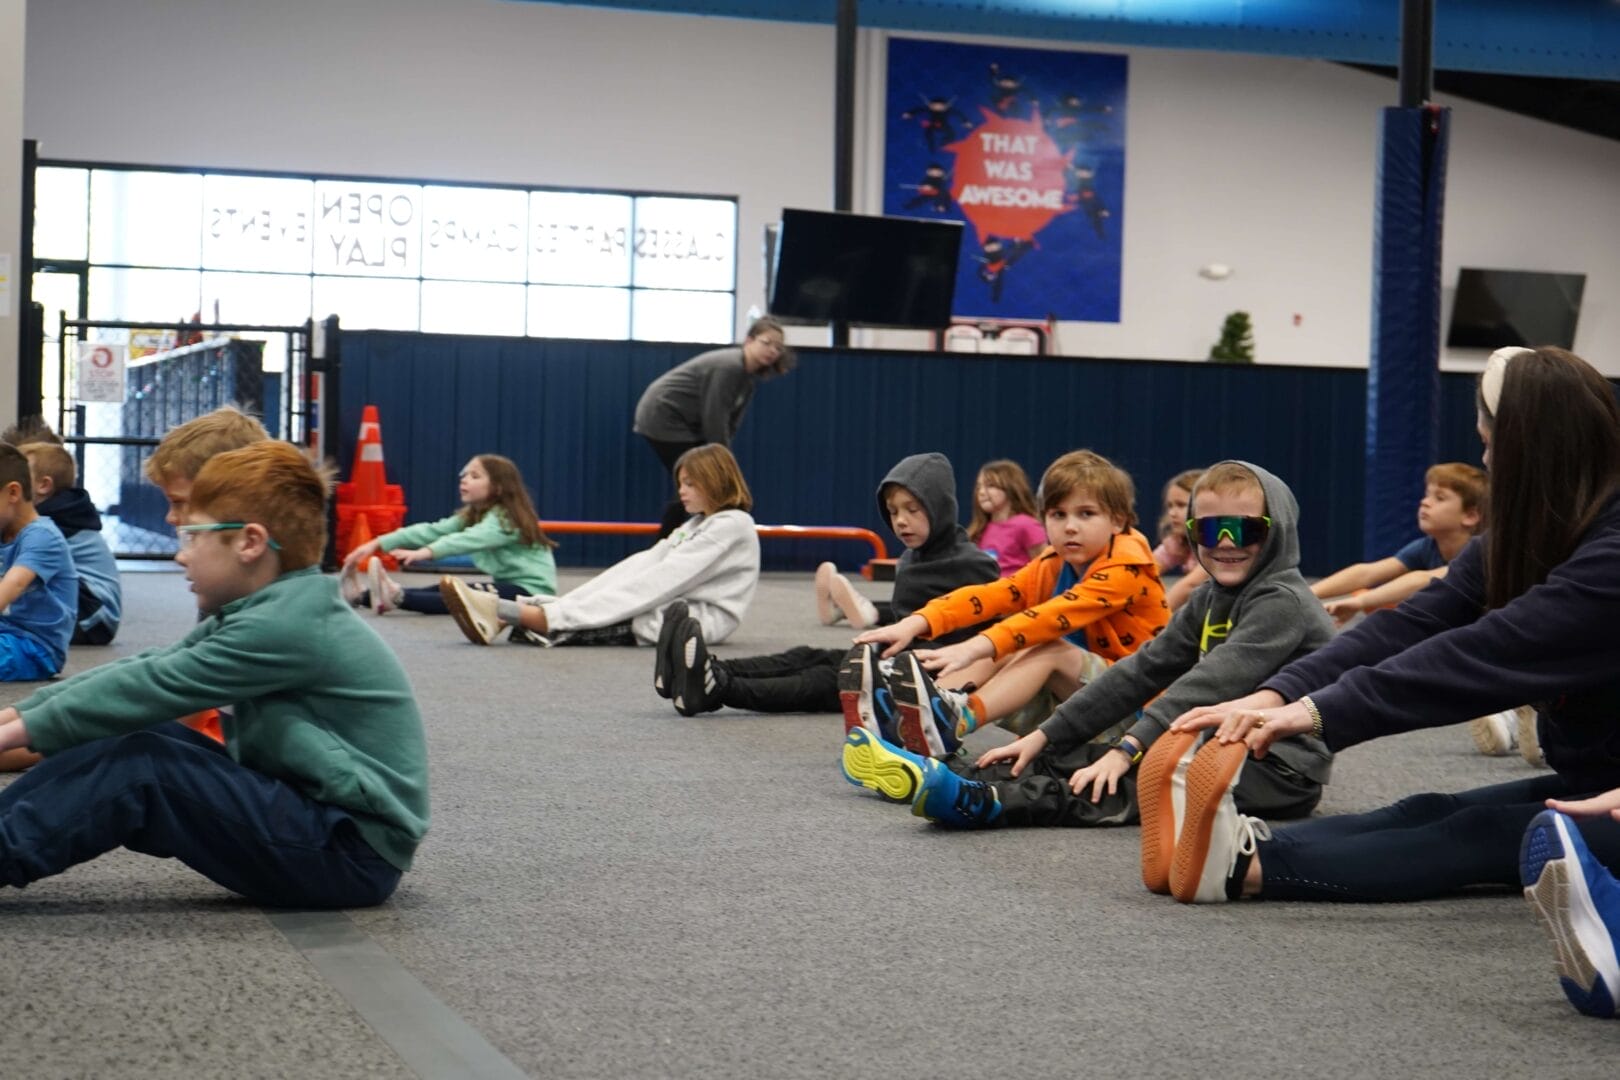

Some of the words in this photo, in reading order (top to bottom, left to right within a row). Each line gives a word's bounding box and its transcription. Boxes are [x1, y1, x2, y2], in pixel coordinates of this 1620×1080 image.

[980, 133, 1038, 154] THAT
[984, 159, 1033, 181] WAS
[958, 184, 1064, 209] AWESOME
